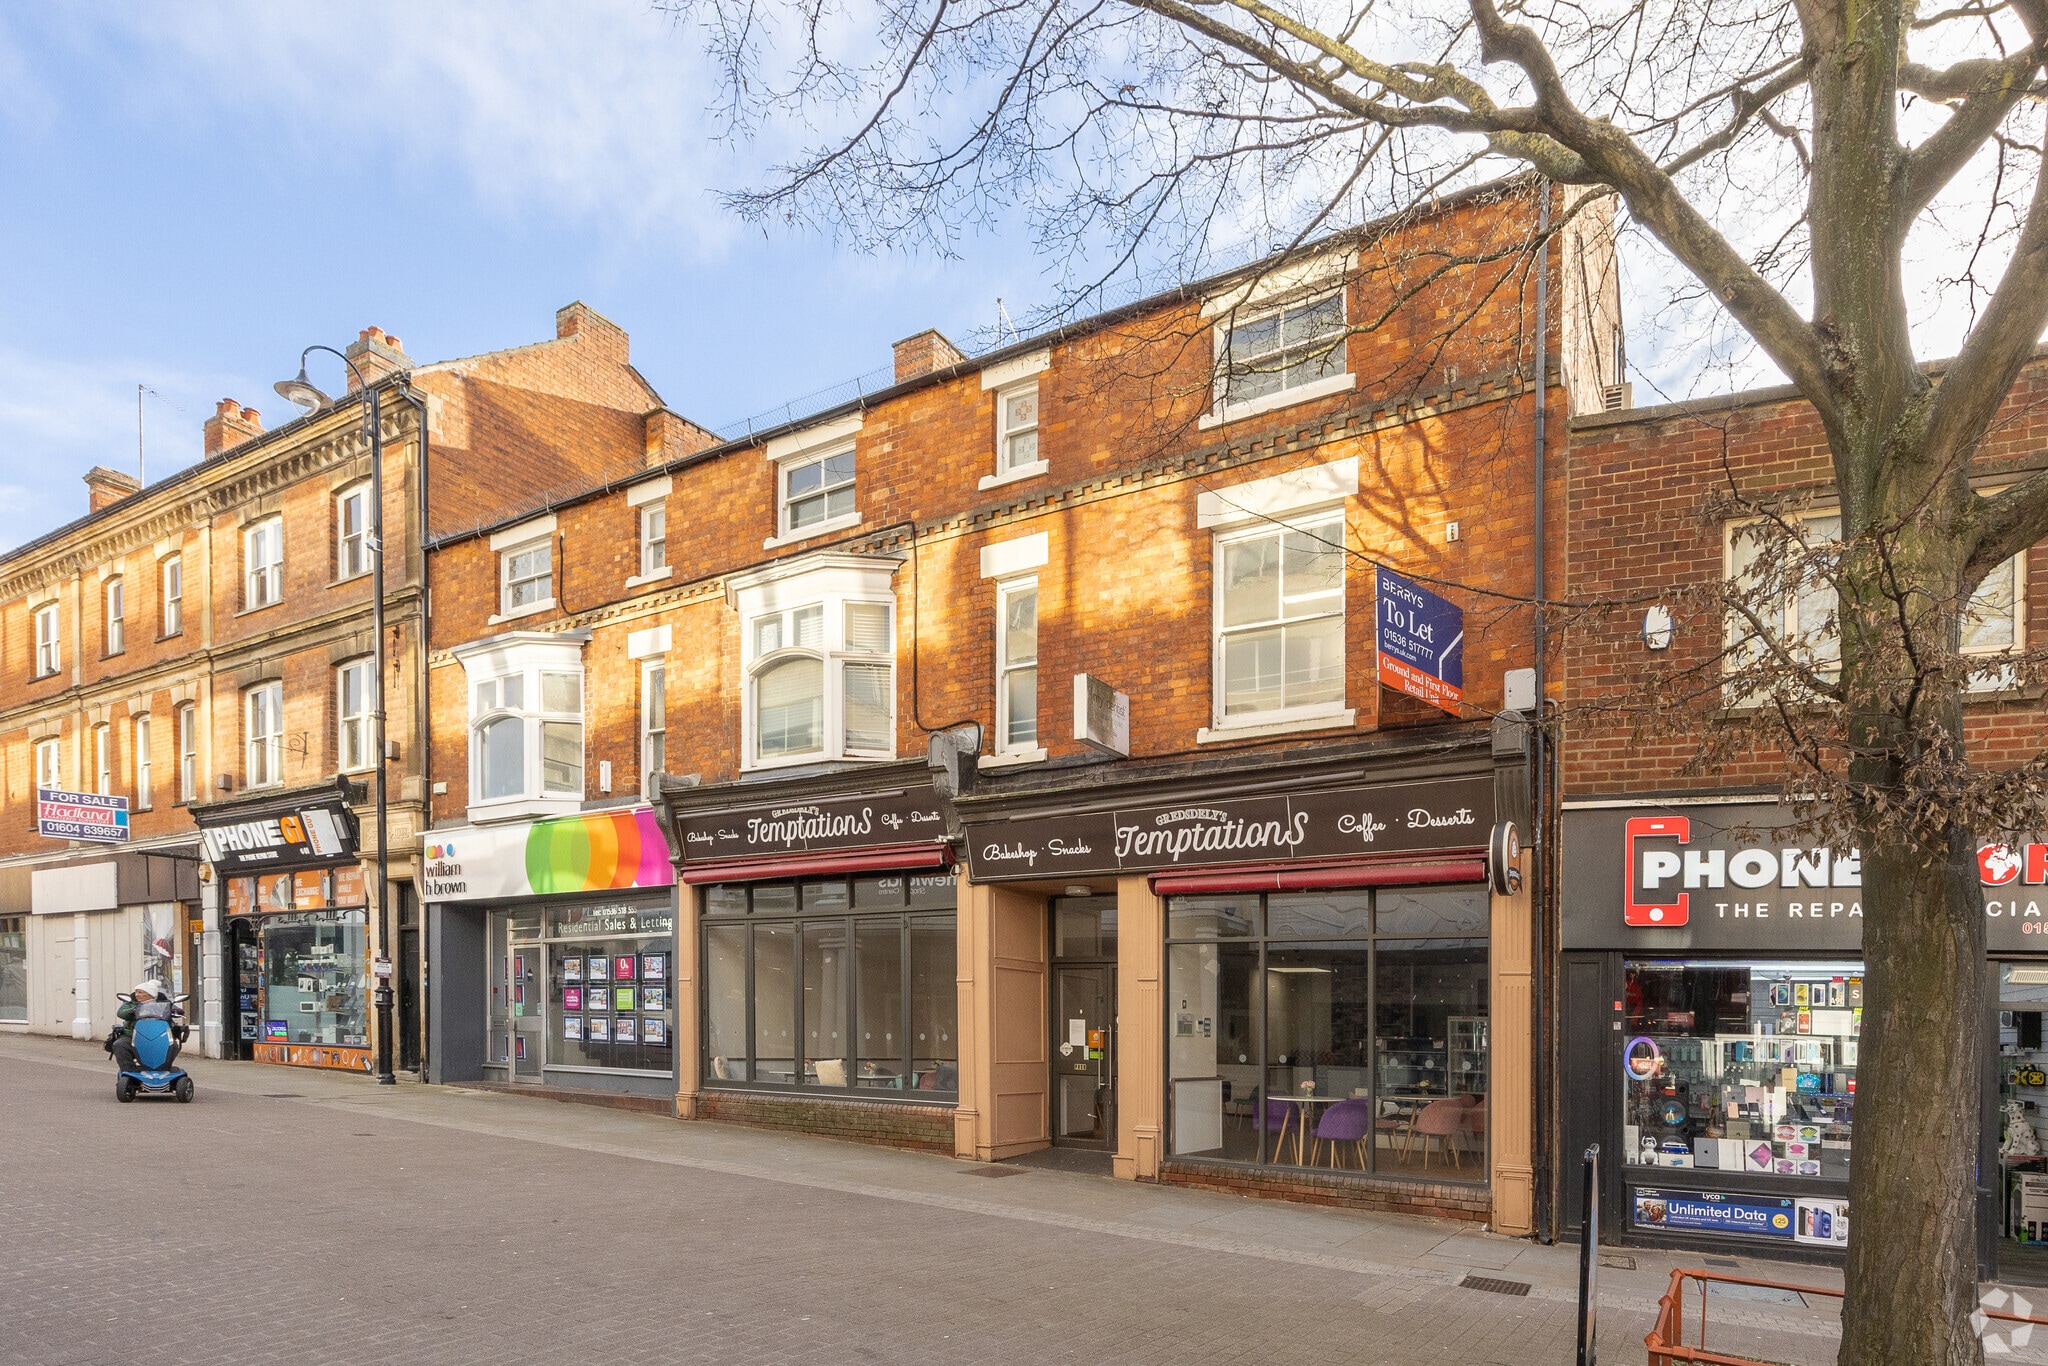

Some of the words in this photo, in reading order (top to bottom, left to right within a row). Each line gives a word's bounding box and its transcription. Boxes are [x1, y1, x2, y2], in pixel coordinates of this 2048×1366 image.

[1382, 577, 1424, 608] BERRYS
[1383, 597, 1404, 628] To
[1408, 610, 1434, 644] Let
[1384, 628, 1406, 647] 01536
[1408, 638, 1433, 660] 517777
[1384, 641, 1417, 662] berrys.uk.com
[1382, 656, 1410, 679] Ground
[1411, 672, 1424, 686] and
[1425, 676, 1440, 693] First
[1442, 682, 1459, 700] Floor
[1404, 680, 1424, 698] Retail
[50, 792, 79, 803] FOR
[82, 796, 118, 807] SALE
[44, 804, 111, 820] Hadland
[47, 822, 80, 833] 01604
[84, 826, 123, 836] 639657
[214, 819, 281, 852] PHONE
[747, 807, 872, 847] Temptations
[881, 813, 903, 830] Coffee
[983, 842, 1037, 866] Bakeshop
[1048, 838, 1092, 856] Snacks
[1115, 812, 1309, 861] Temptations
[1338, 813, 1386, 842] Coffee
[1407, 808, 1475, 828] Desserts
[426, 861, 460, 877] william
[1642, 848, 1862, 888] PHONE
[426, 880, 432, 895] h
[434, 879, 466, 895] brown
[1715, 903, 1769, 918] THE
[558, 919, 601, 933] Residential
[605, 919, 626, 930] Sales
[629, 917, 636, 929] &
[1702, 1193, 1720, 1201] Lyca
[1669, 1203, 1731, 1218] Unlimited
[1734, 1207, 1767, 1221] Data
